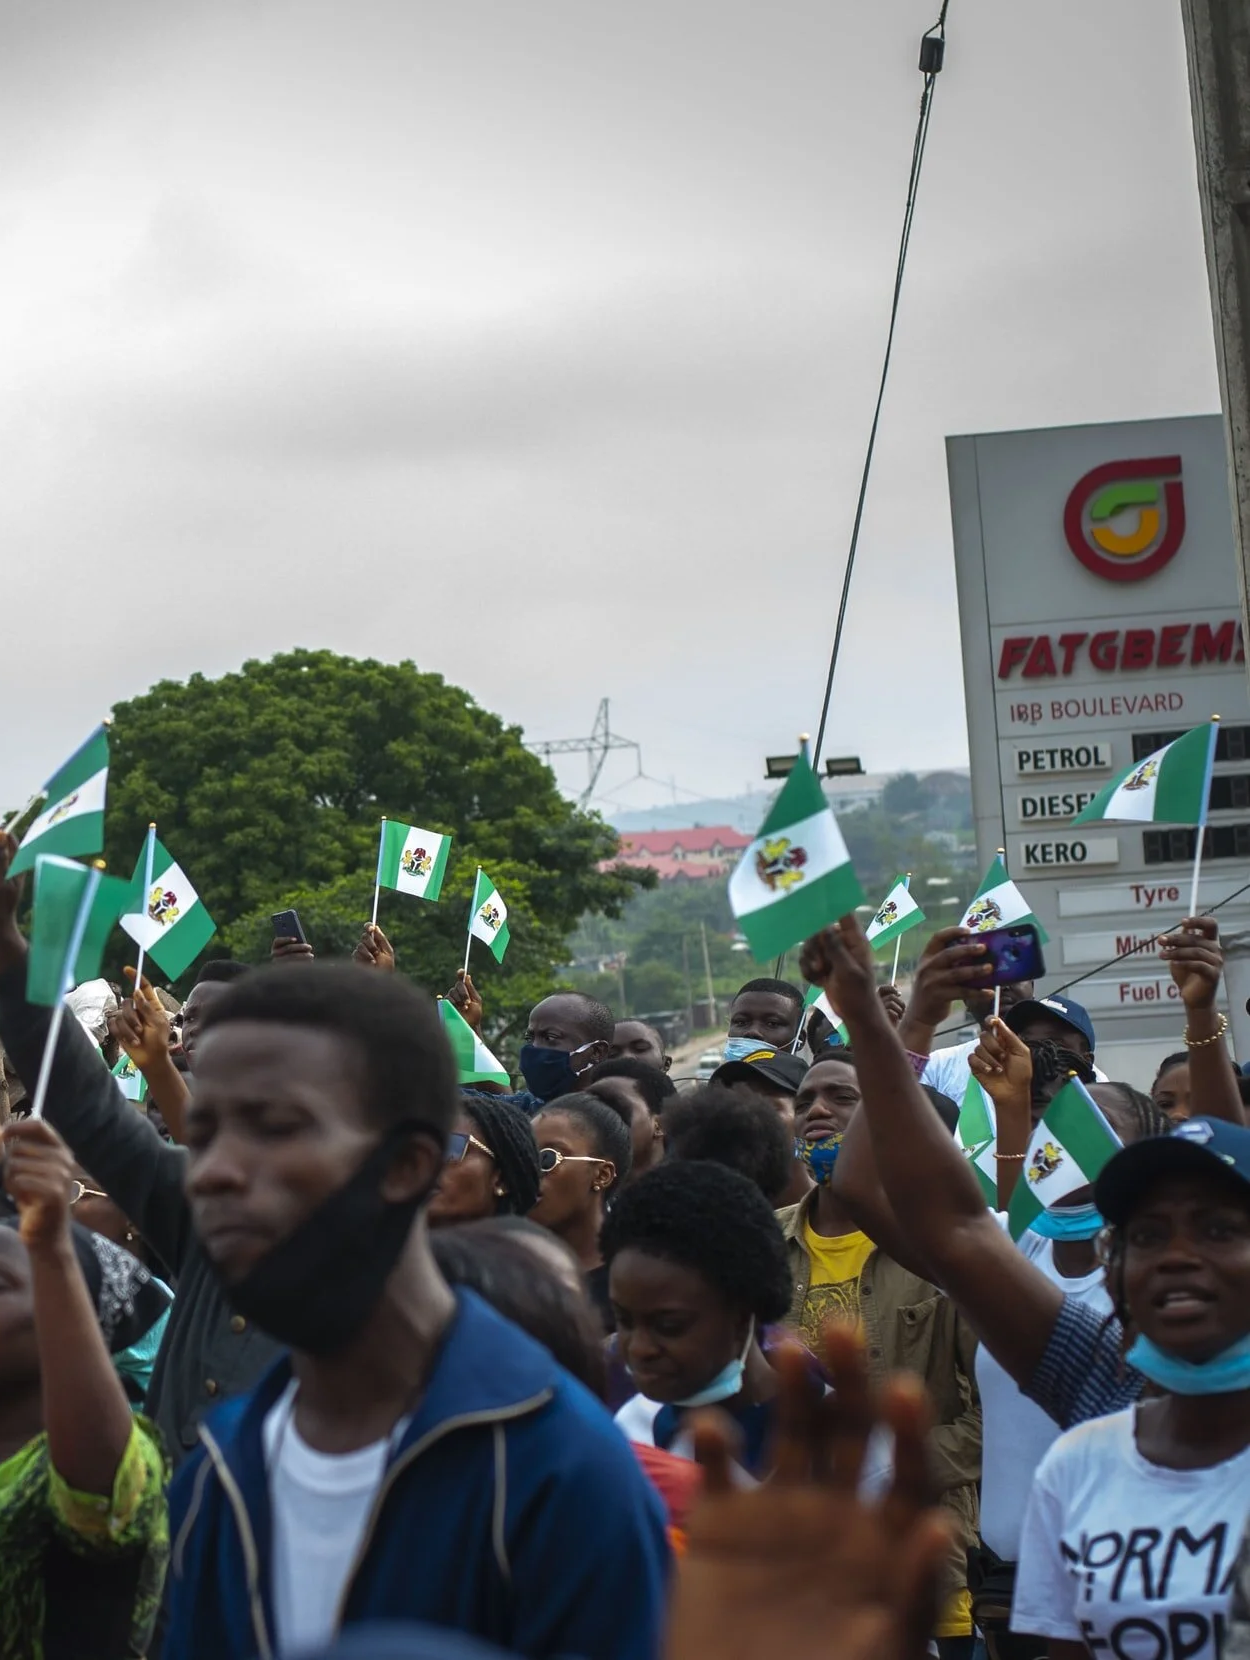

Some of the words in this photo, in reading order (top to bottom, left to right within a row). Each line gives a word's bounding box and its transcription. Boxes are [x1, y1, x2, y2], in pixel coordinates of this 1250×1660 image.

[1010, 702, 1043, 723] IBB
[1051, 692, 1183, 720] BOULEVARD
[1017, 745, 1106, 771] PETROL
[1025, 841, 1087, 864] KERO
[1130, 885, 1179, 908] Tyre
[1116, 933, 1155, 956] Mini
[1119, 981, 1160, 1002] Fuel
